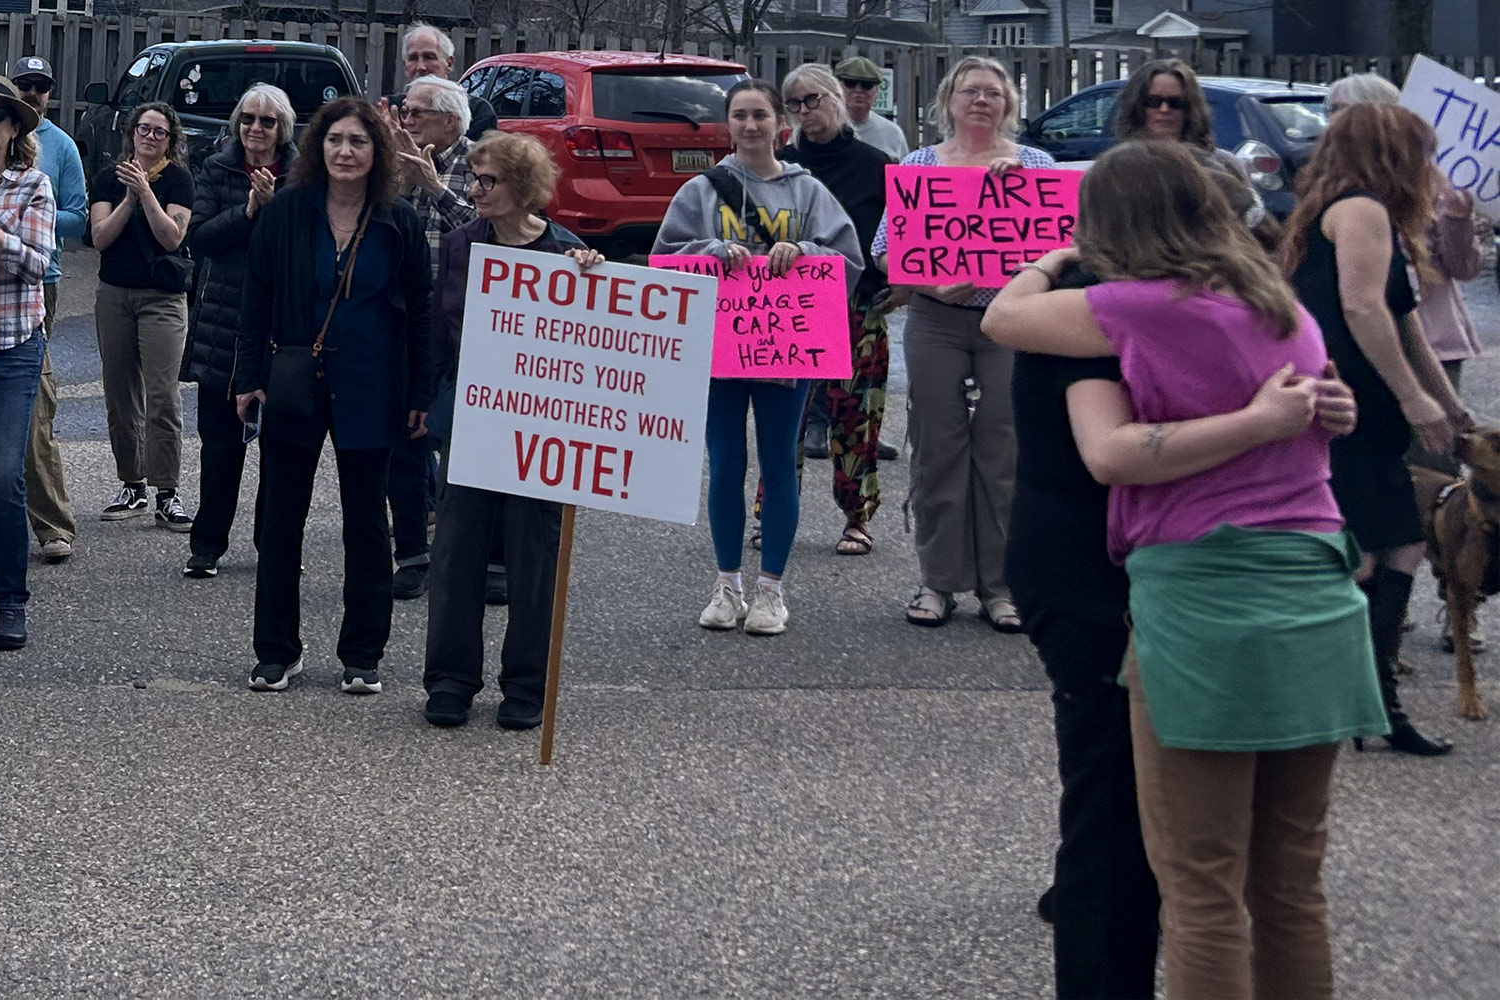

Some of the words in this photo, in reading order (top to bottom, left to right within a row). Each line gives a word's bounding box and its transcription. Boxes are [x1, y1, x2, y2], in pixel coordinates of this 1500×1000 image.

[893, 175, 957, 210] WE
[977, 172, 1064, 209] ARE
[924, 214, 1075, 242] FOREVER
[795, 262, 837, 281] FOR
[901, 246, 1051, 277] GRATEF
[481, 258, 699, 325] PROTECT
[716, 294, 815, 312] OURAGE
[491, 309, 525, 336] THE
[535, 316, 682, 361] REPRODUCTIVE
[732, 311, 810, 335] CARE
[737, 343, 826, 369] HEART
[757, 335, 776, 346] and
[515, 352, 585, 385] RIGHTS
[595, 365, 646, 395] YOUR
[465, 384, 627, 432] GRANDMOTHERS
[638, 412, 688, 443] WON.
[514, 430, 634, 500] VOTE!
